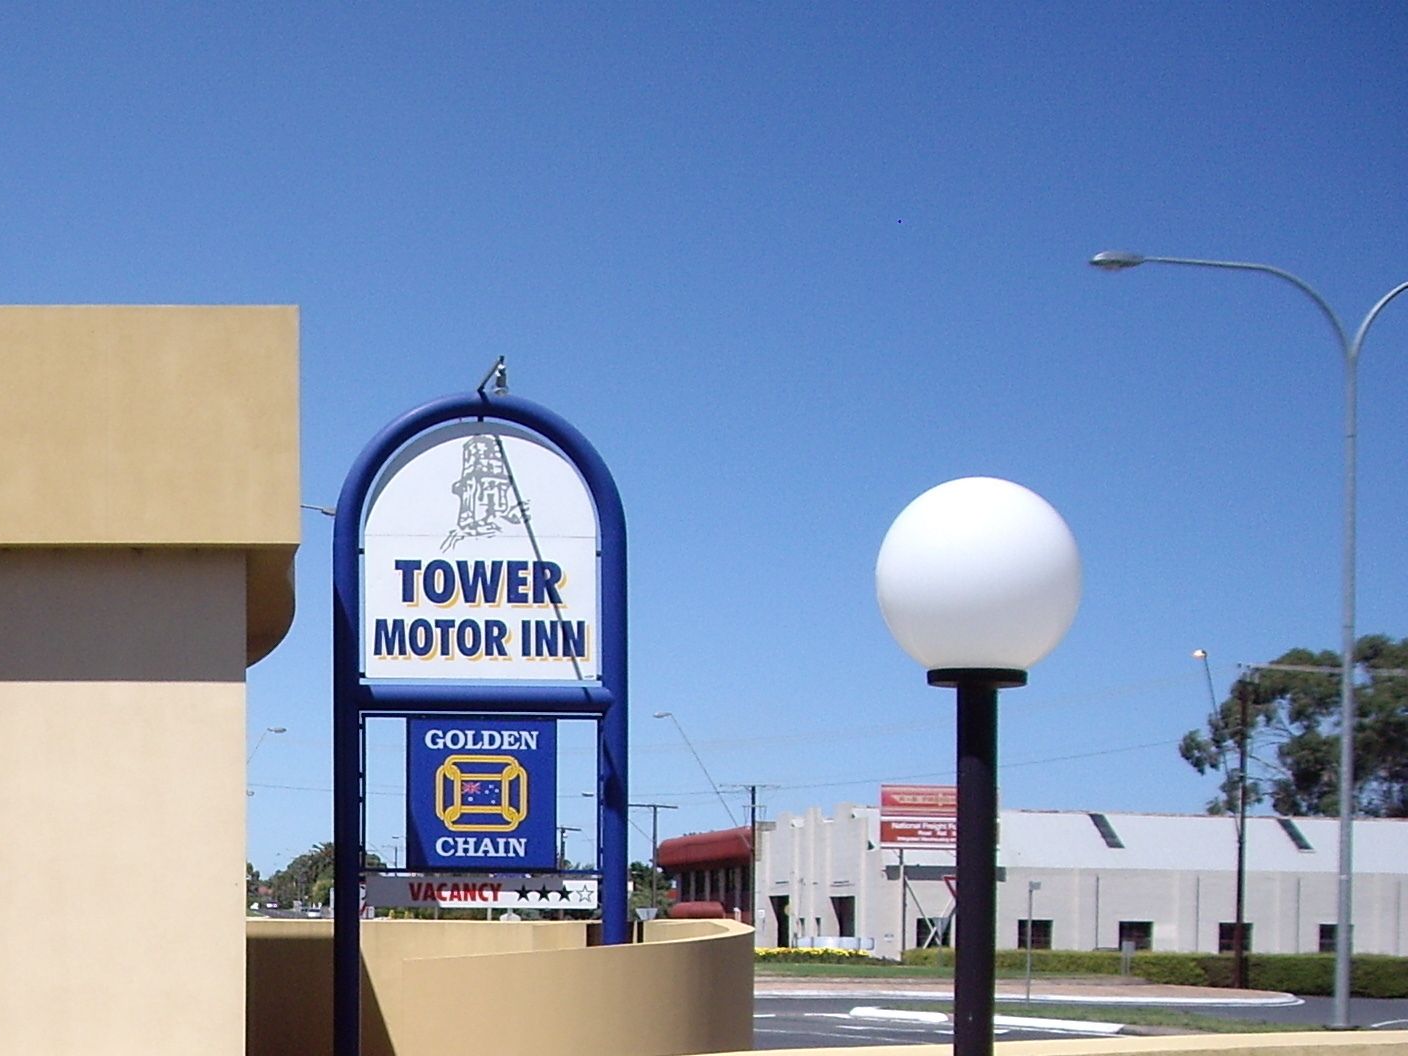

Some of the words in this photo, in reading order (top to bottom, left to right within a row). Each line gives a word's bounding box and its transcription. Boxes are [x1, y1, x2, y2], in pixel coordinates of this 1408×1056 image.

[395, 559, 565, 605] TOWER
[373, 618, 509, 658] MOTOR
[521, 619, 588, 659] INN
[425, 729, 539, 750] GOLDEN
[436, 837, 527, 858] CHAIN
[409, 882, 503, 902] VACANCY
